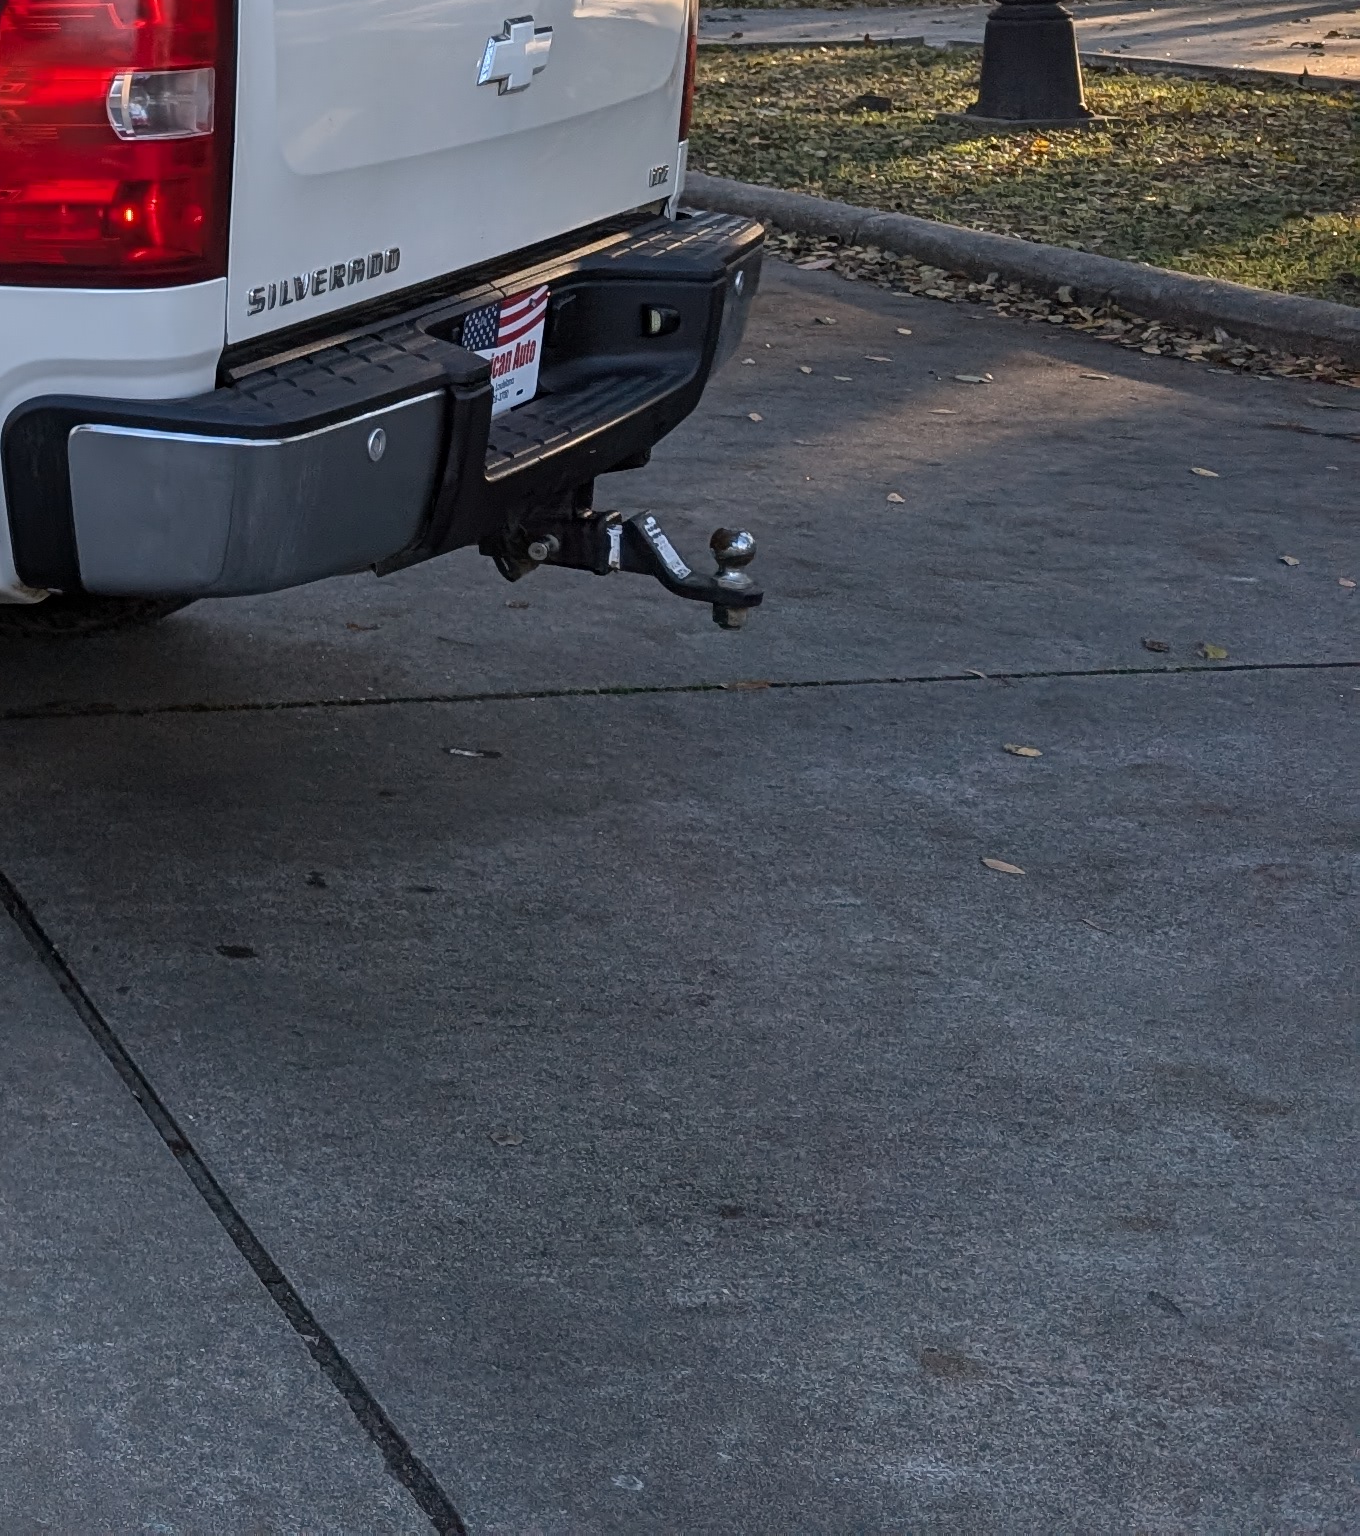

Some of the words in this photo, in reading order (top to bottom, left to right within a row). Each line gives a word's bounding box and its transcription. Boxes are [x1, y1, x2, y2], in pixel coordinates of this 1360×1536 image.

[247, 247, 401, 317] SILVERADO
[491, 350, 513, 380] ican
[512, 339, 537, 371] Auto
